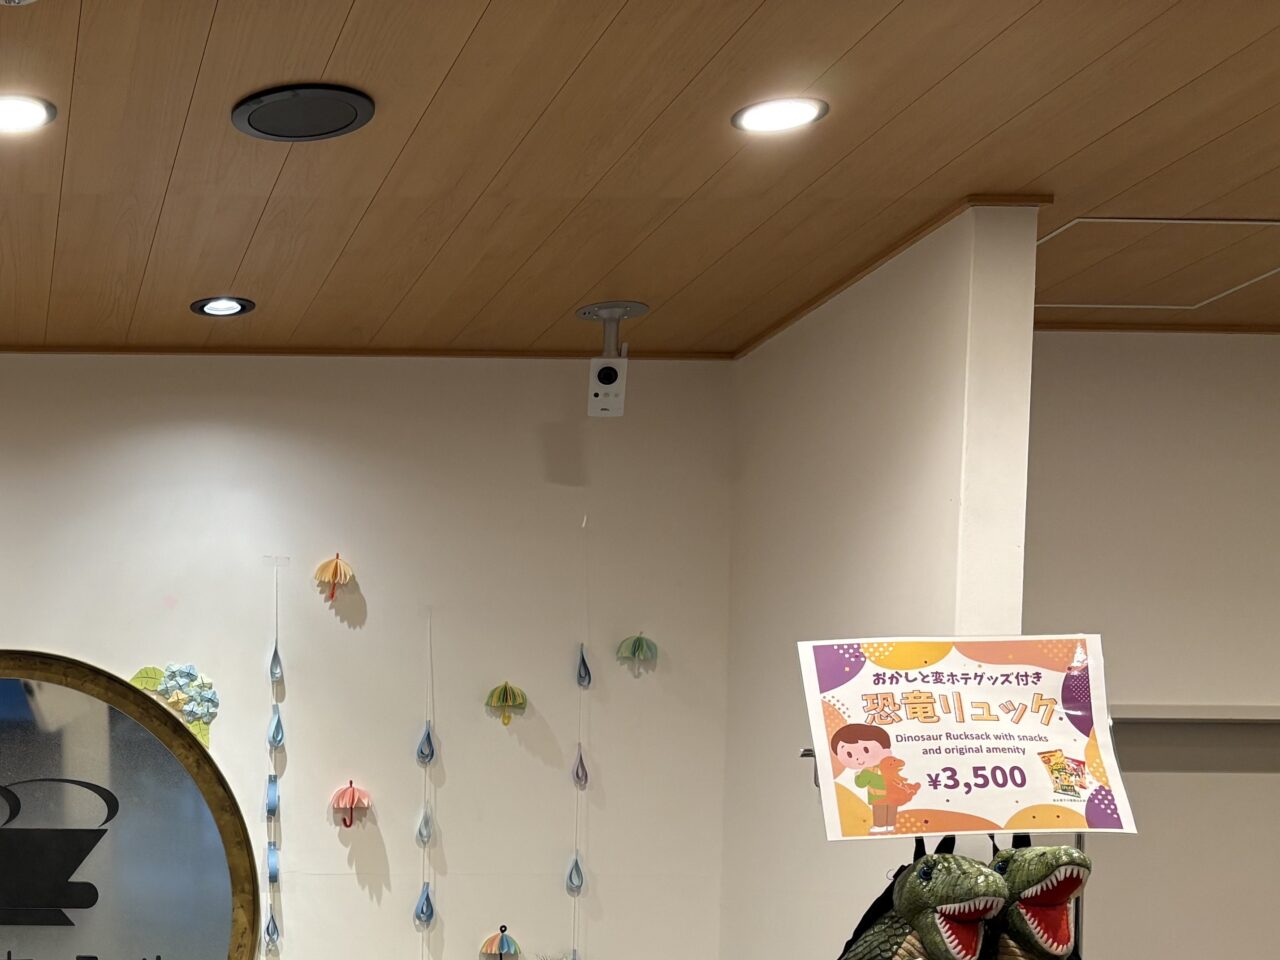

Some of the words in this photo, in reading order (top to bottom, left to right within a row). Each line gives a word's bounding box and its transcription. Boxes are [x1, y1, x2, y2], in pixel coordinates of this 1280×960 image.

[872, 671, 1043, 686] おかしと変ホテグッズ付き
[861, 690, 1058, 726] 恐竜リュック
[896, 732, 942, 743] Dinosaur
[945, 731, 992, 742] Rucksack
[993, 731, 1015, 742] with
[1017, 732, 1049, 742] snacks
[922, 745, 941, 755] and
[945, 744, 983, 757] original
[986, 746, 1026, 756] amenity
[927, 766, 1027, 795] ¥3,500
